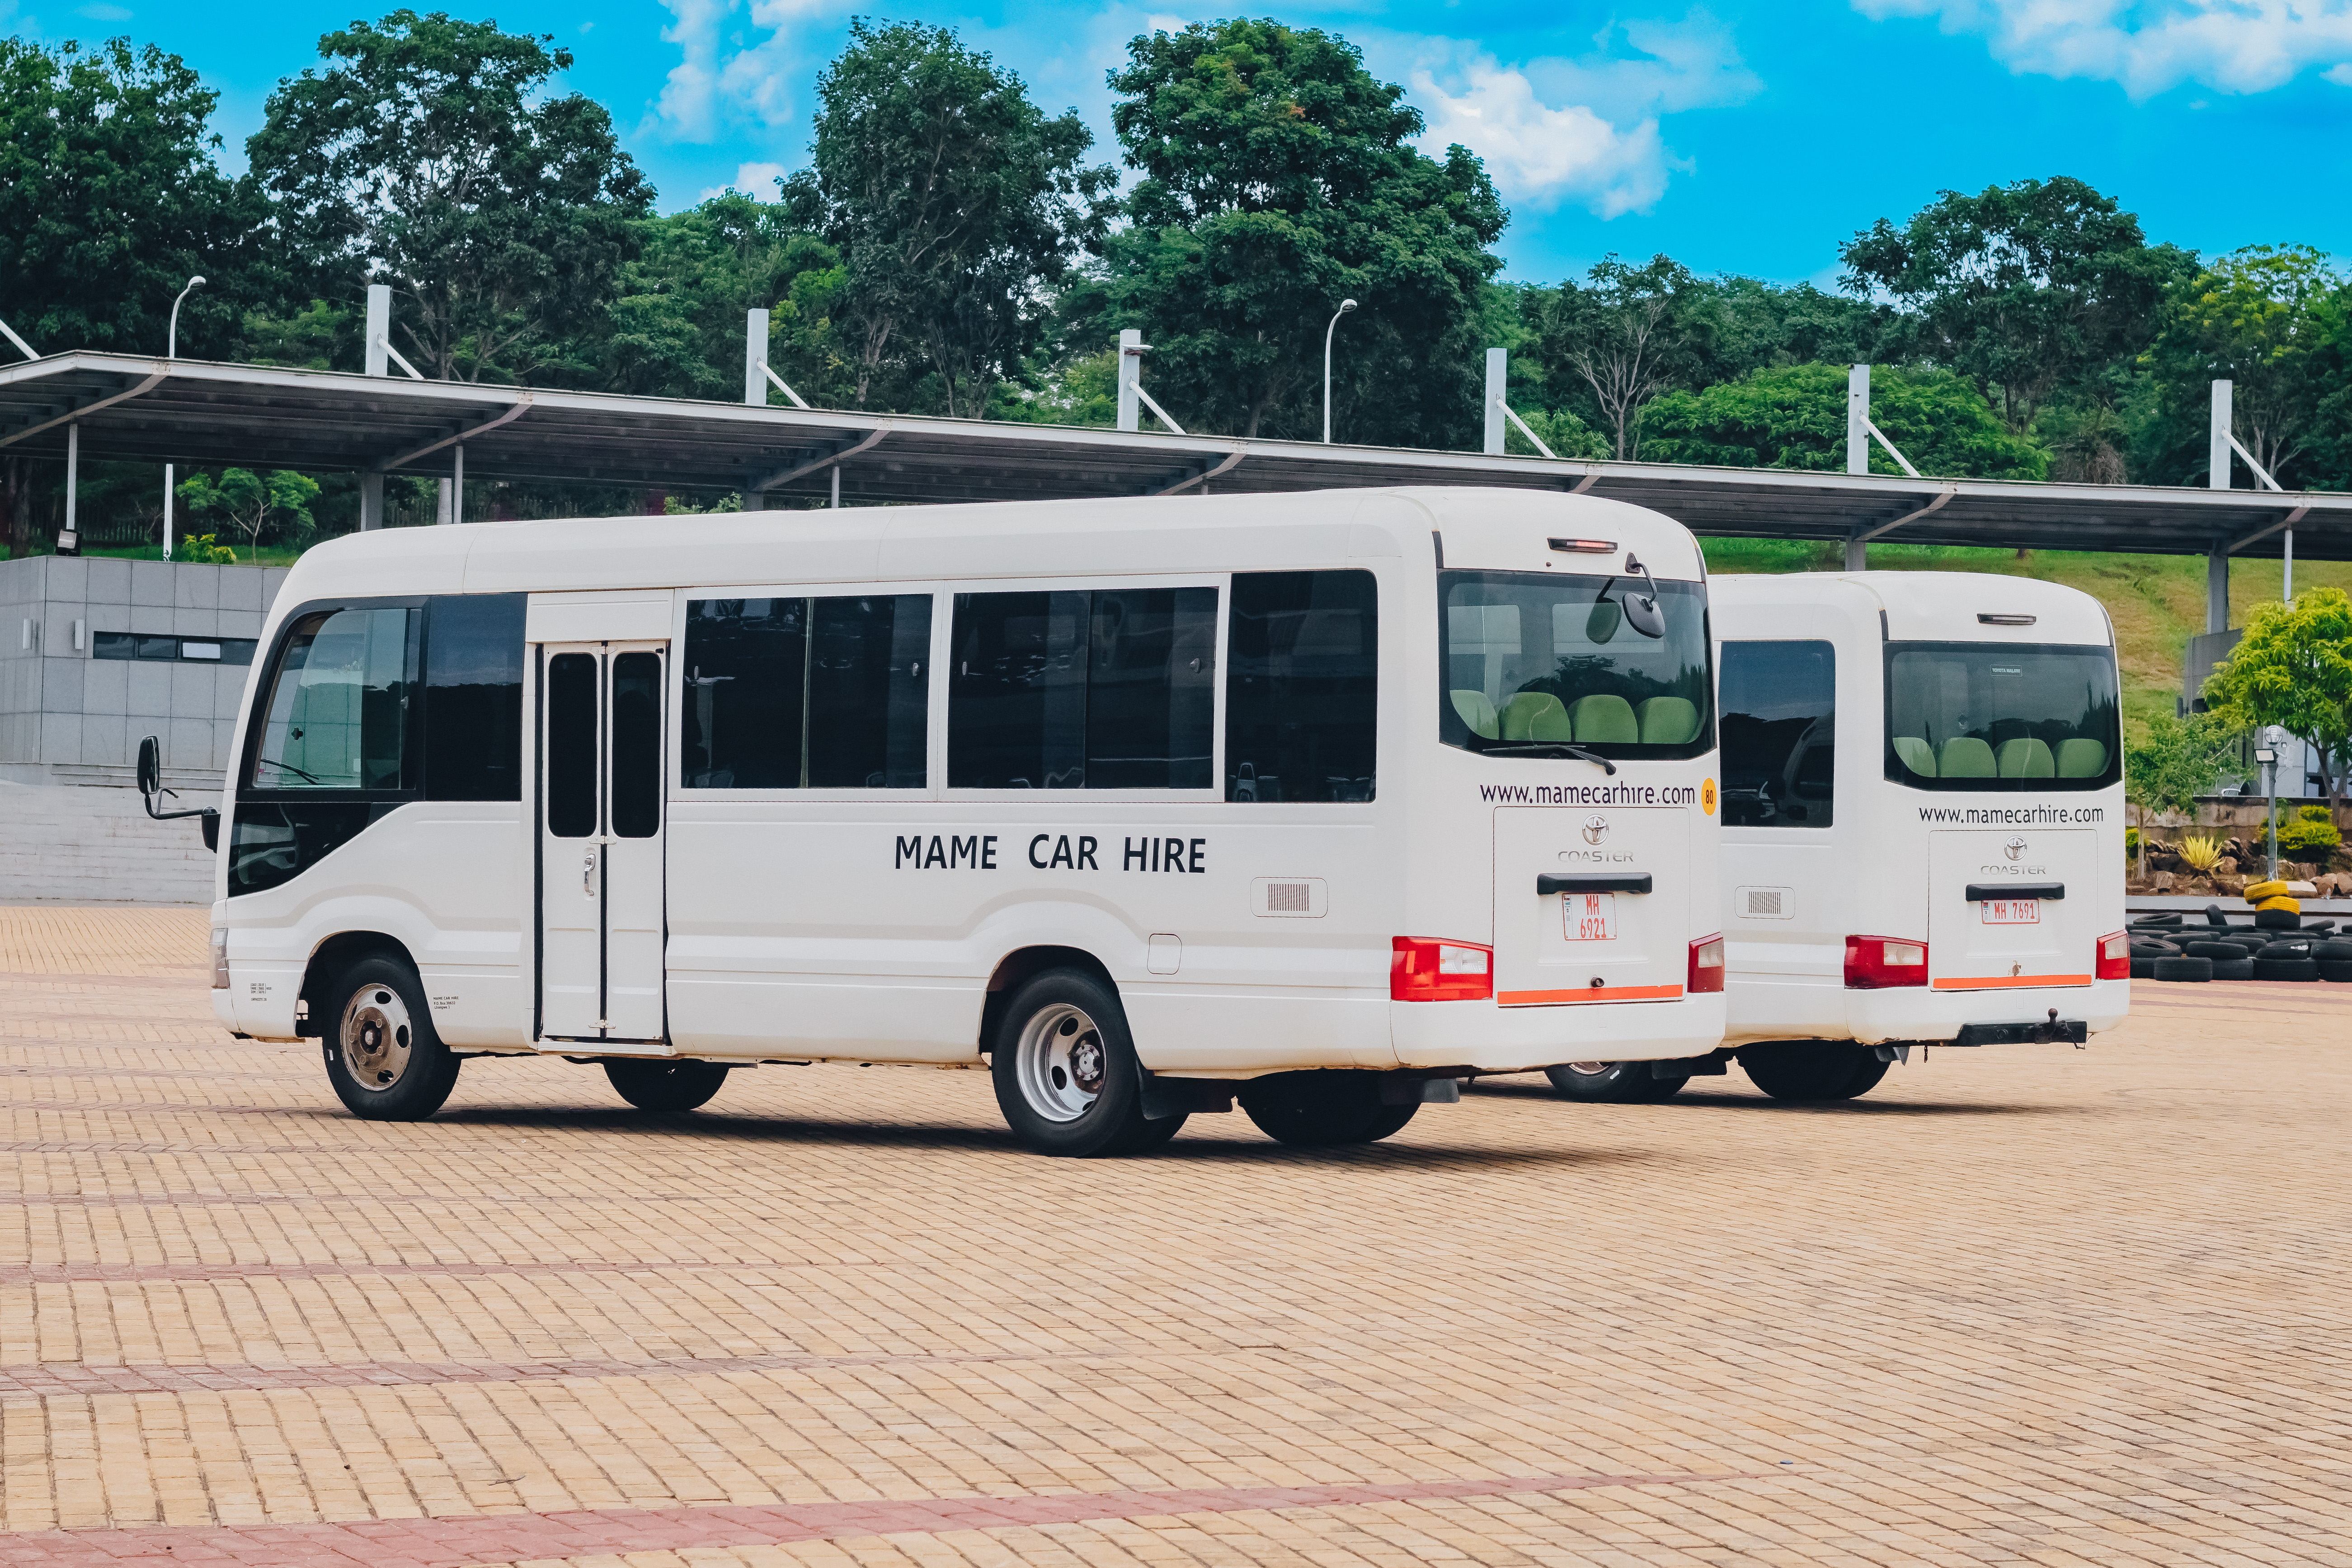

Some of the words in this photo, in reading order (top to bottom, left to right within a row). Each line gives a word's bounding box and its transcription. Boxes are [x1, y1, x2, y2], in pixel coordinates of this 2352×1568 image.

[1480, 780, 1695, 804] www.mamecarhire.com
[1706, 789, 1713, 805] 80
[1919, 804, 2103, 824] www.mamecarhire.com
[895, 835, 998, 870] MAME
[1028, 833, 1099, 871] CAR
[1123, 837, 1206, 874] HIRE
[1557, 850, 1634, 863] COASTER
[1980, 865, 2046, 876] COASTER
[1586, 895, 1599, 915] MH
[1994, 902, 2006, 919] MH
[2013, 902, 2035, 919] 7691
[1580, 918, 1607, 938] 6921
